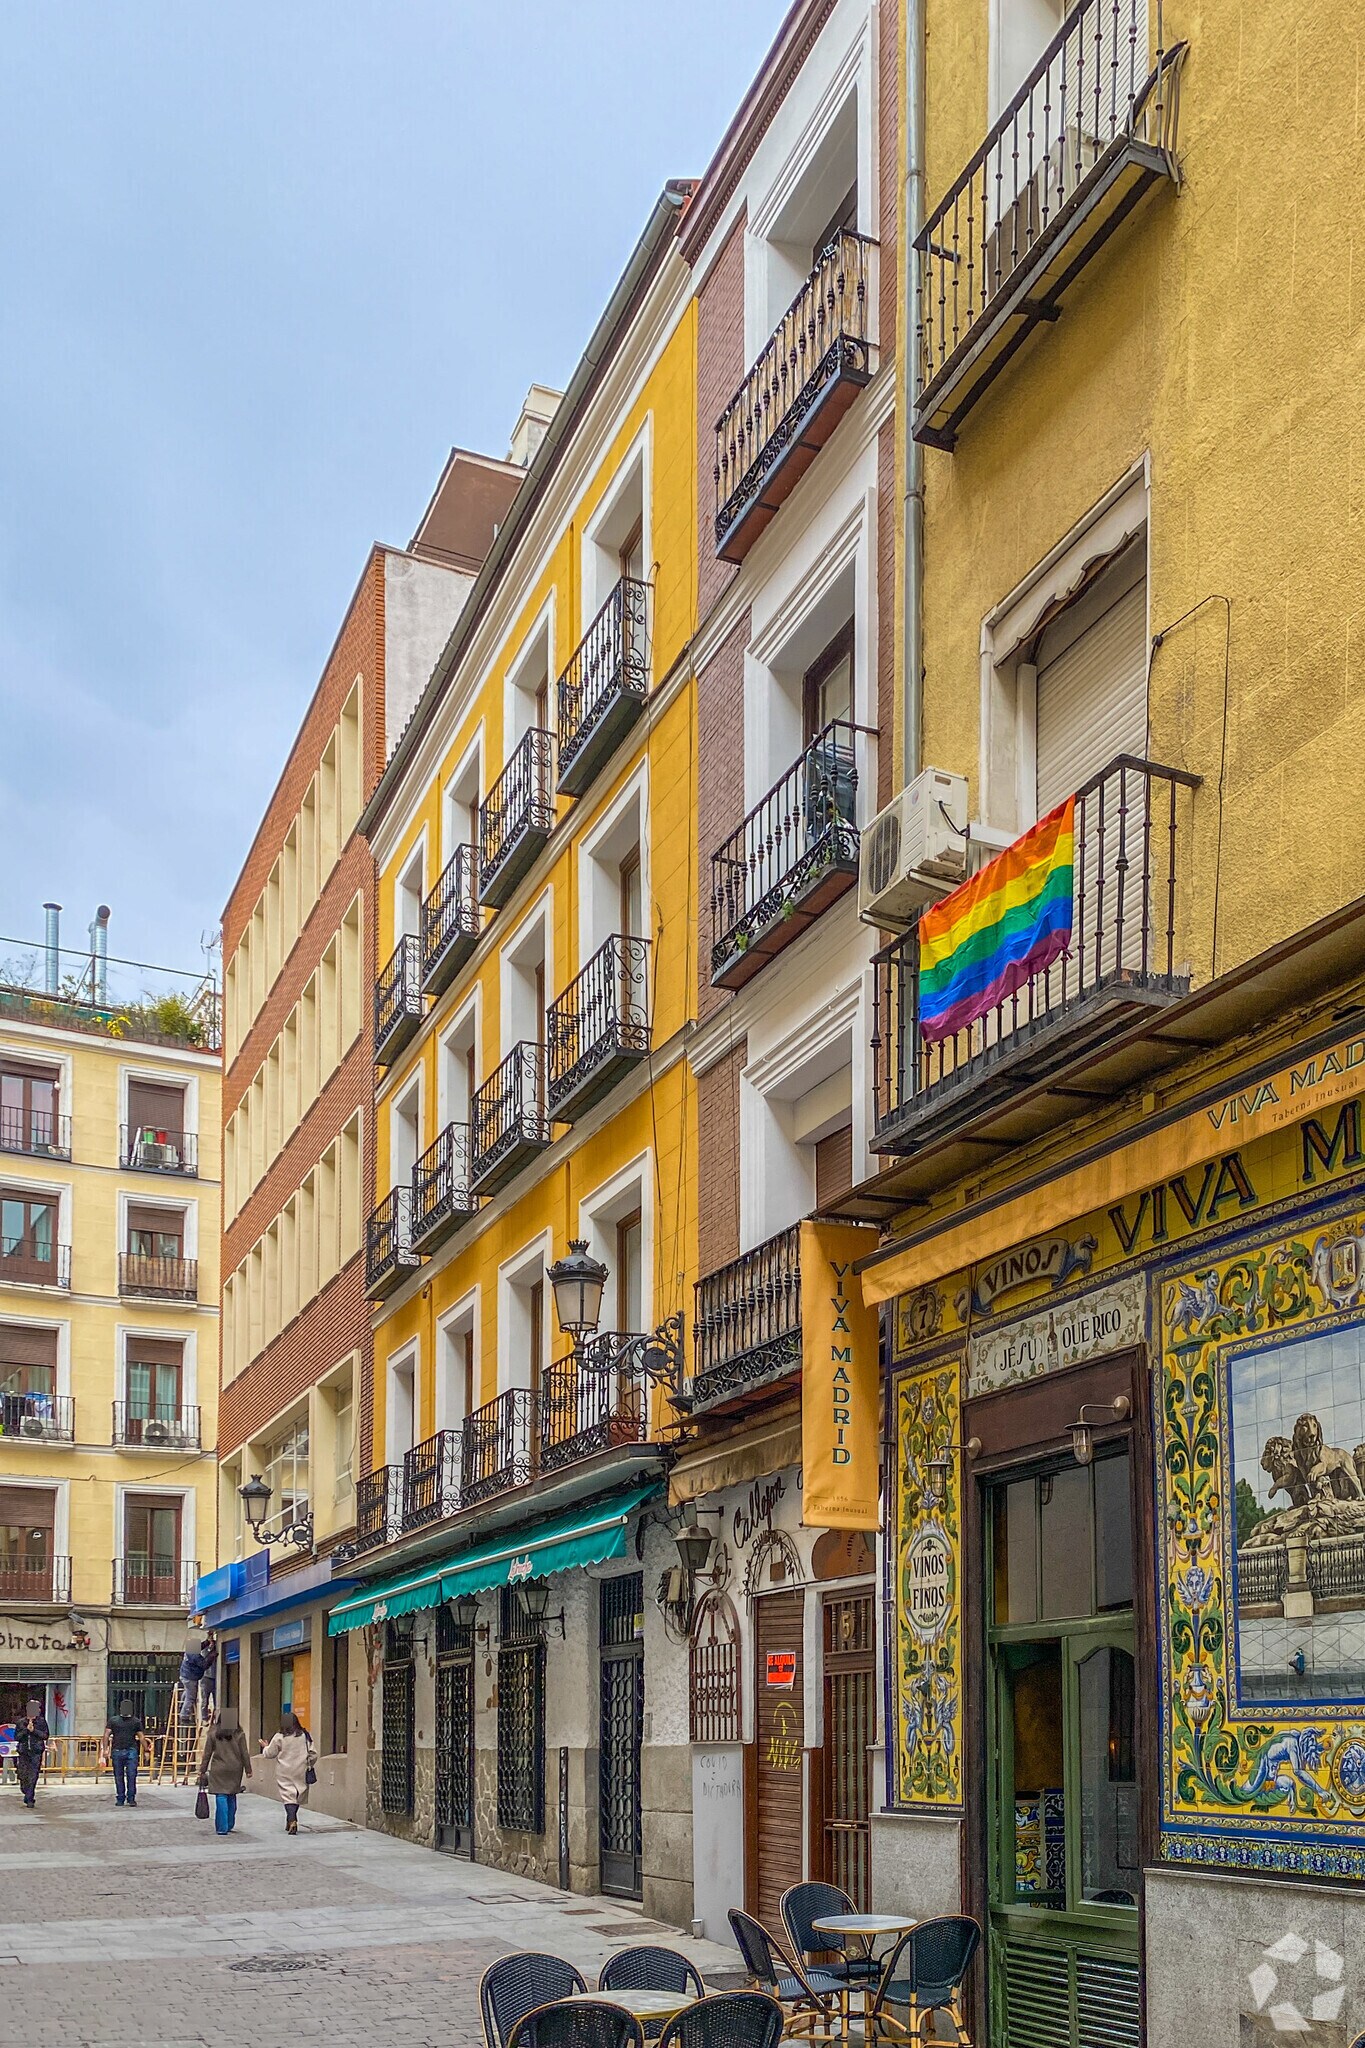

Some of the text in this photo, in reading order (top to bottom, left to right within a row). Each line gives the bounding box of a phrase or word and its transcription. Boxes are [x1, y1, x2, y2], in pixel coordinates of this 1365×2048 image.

[1207, 1038, 1365, 1130] VIVA MAD
[1272, 1076, 1358, 1122] Taberna Inusual
[1107, 1151, 1259, 1255] VIVA
[983, 1244, 1059, 1295] VINOS
[918, 1303, 928, 1330] 7
[1092, 1308, 1121, 1340] RICO
[830, 1261, 852, 1465] VIVA MADRID
[913, 1553, 944, 1578] VINOS
[913, 1586, 945, 1610] FINOS
[842, 1614, 851, 1639] 5
